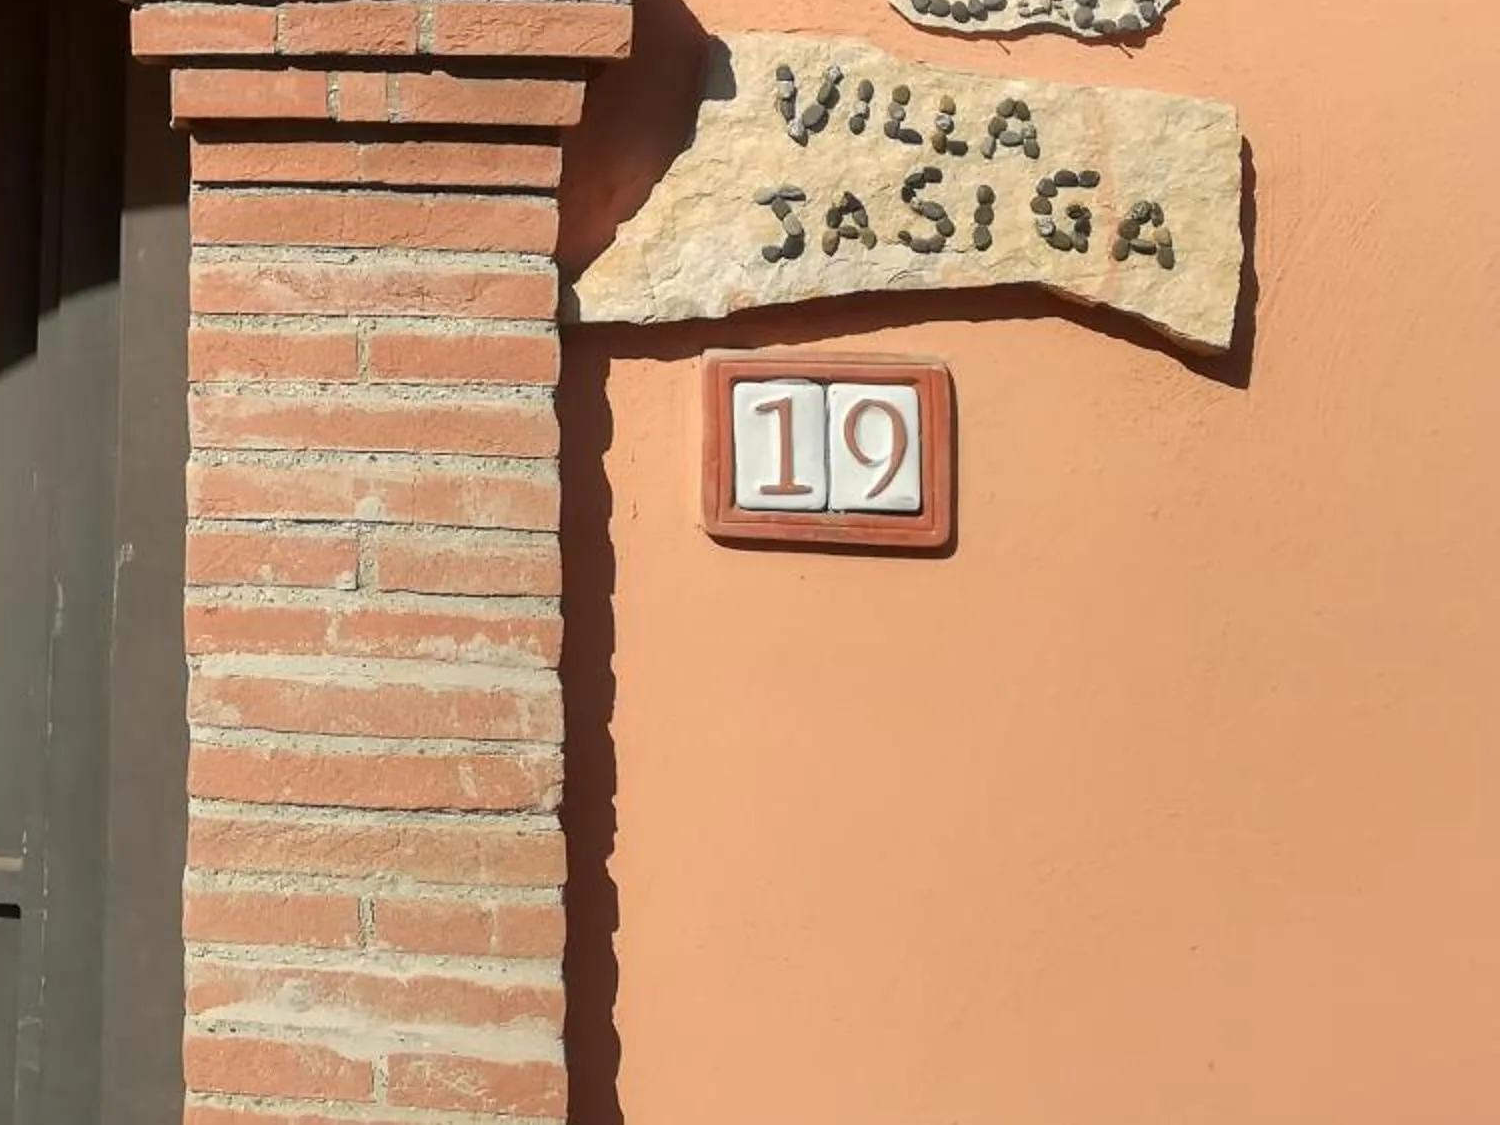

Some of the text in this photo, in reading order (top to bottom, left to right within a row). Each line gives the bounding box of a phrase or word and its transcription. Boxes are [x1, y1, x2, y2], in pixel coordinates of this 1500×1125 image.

[776, 64, 1041, 160] VILLA
[754, 166, 1176, 270] JASIGA
[754, 396, 910, 499] 19
